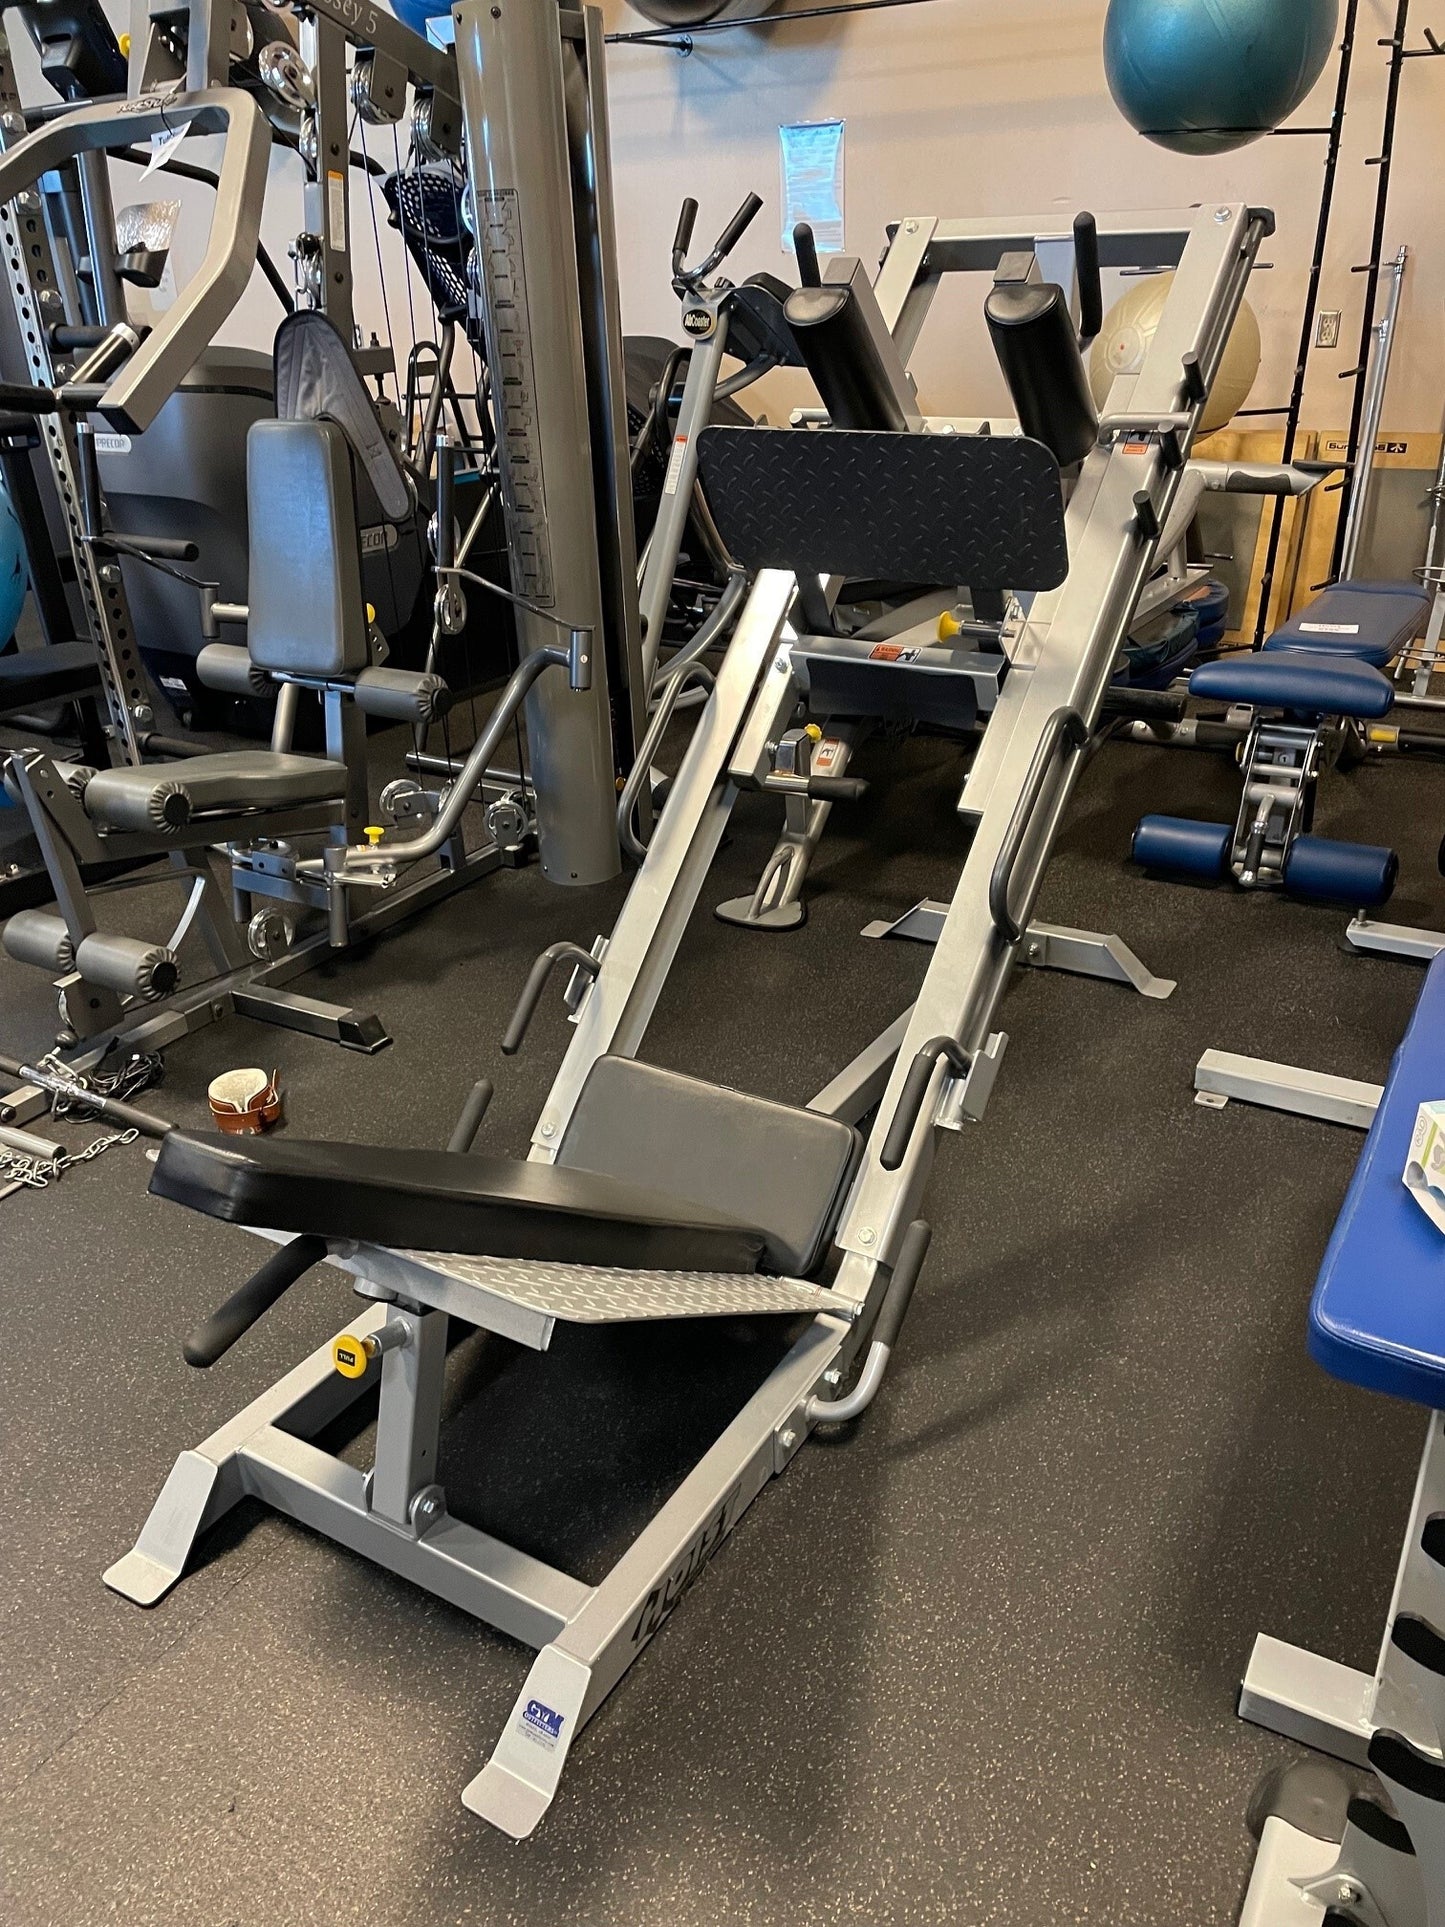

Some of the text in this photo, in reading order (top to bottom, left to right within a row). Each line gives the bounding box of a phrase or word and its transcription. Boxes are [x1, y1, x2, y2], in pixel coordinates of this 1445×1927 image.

[366, 11, 378, 34] 5
[96, 438, 125, 449] PRECOR
[339, 1352, 354, 1363] PULL
[631, 1482, 742, 1649] HOIST
[523, 1711, 559, 1736] OUTFITTERS
[526, 1699, 565, 1730] GYM
